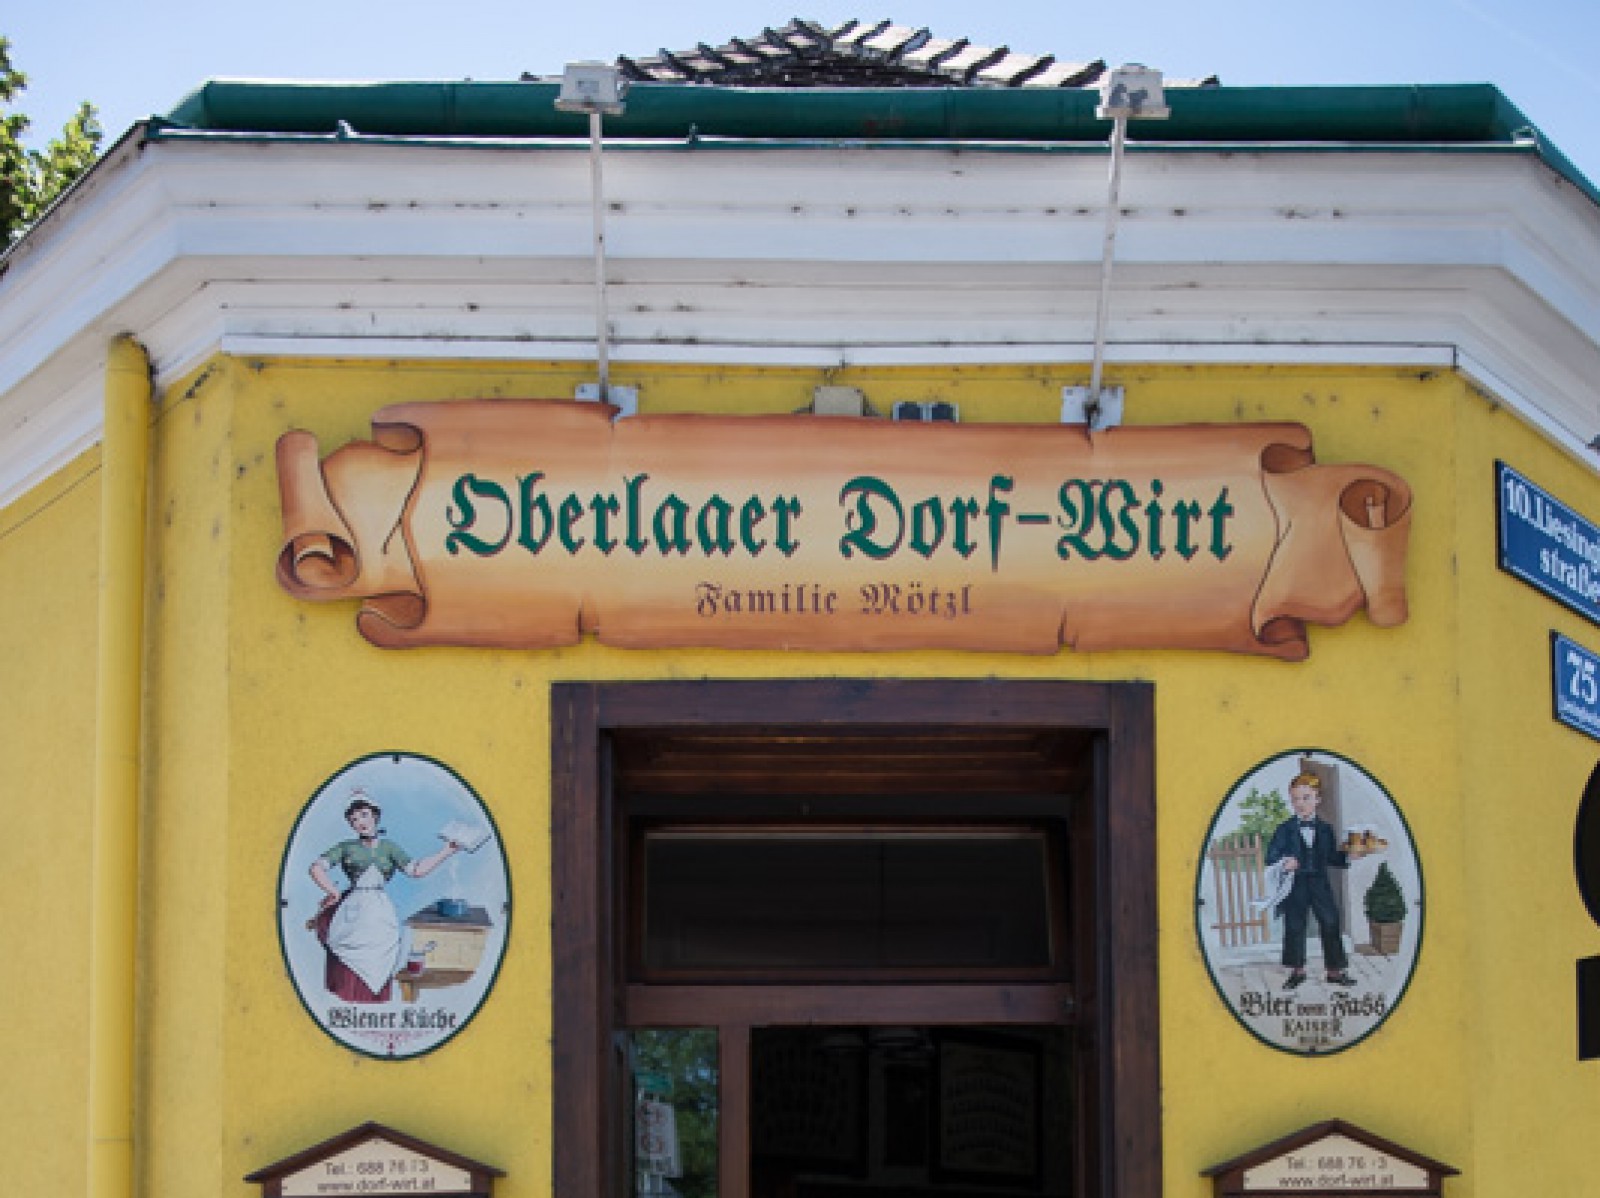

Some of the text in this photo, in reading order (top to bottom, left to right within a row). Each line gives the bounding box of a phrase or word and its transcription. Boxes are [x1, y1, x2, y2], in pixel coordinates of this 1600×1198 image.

[446, 473, 1235, 573] Oberlaaer Dorf-Wirt
[696, 582, 972, 620] Familie Mötzl
[1566, 650, 1598, 705] 75
[328, 1006, 457, 1031] Wiener Küche
[1240, 992, 1293, 1016] Bier
[1282, 1018, 1344, 1037] KAISER
